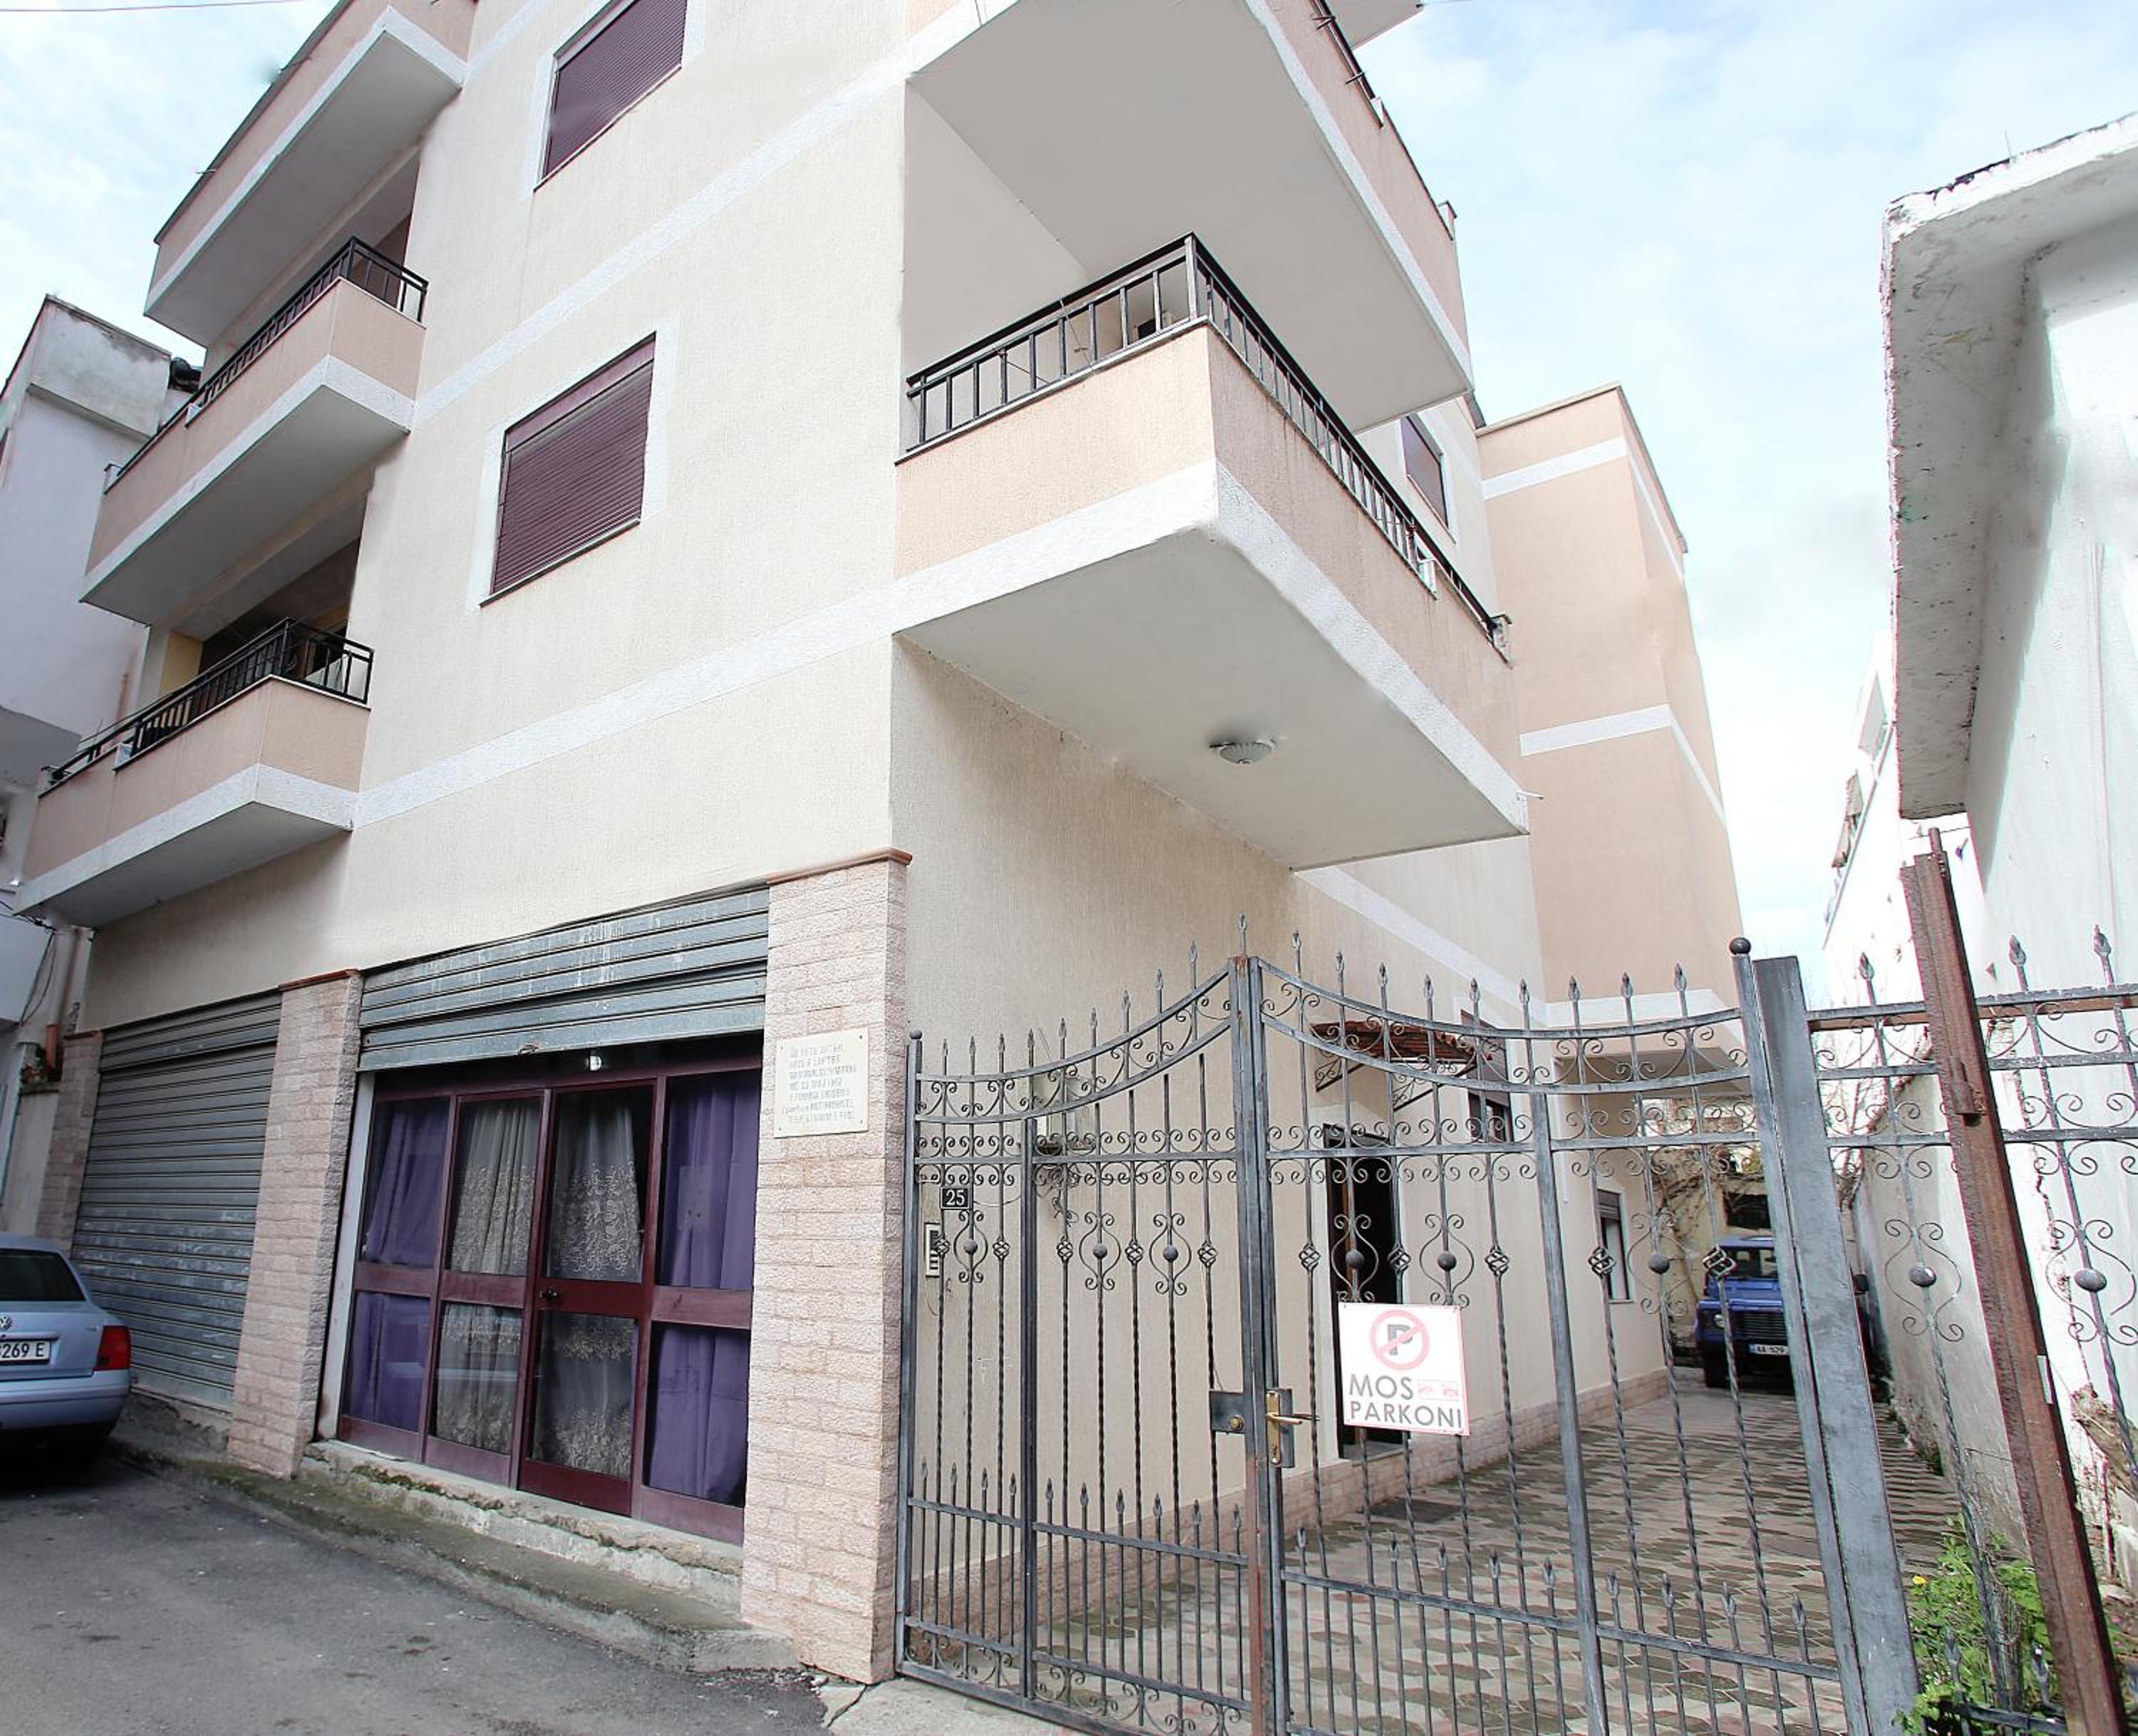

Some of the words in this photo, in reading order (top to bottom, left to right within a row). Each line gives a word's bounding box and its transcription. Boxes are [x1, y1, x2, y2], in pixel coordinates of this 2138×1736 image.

[946, 1189, 965, 1207] 25
[0, 1342, 30, 1359] 269
[36, 1342, 45, 1358] E
[1349, 1373, 1414, 1400] MOS
[1350, 1400, 1462, 1429] PARKONI
